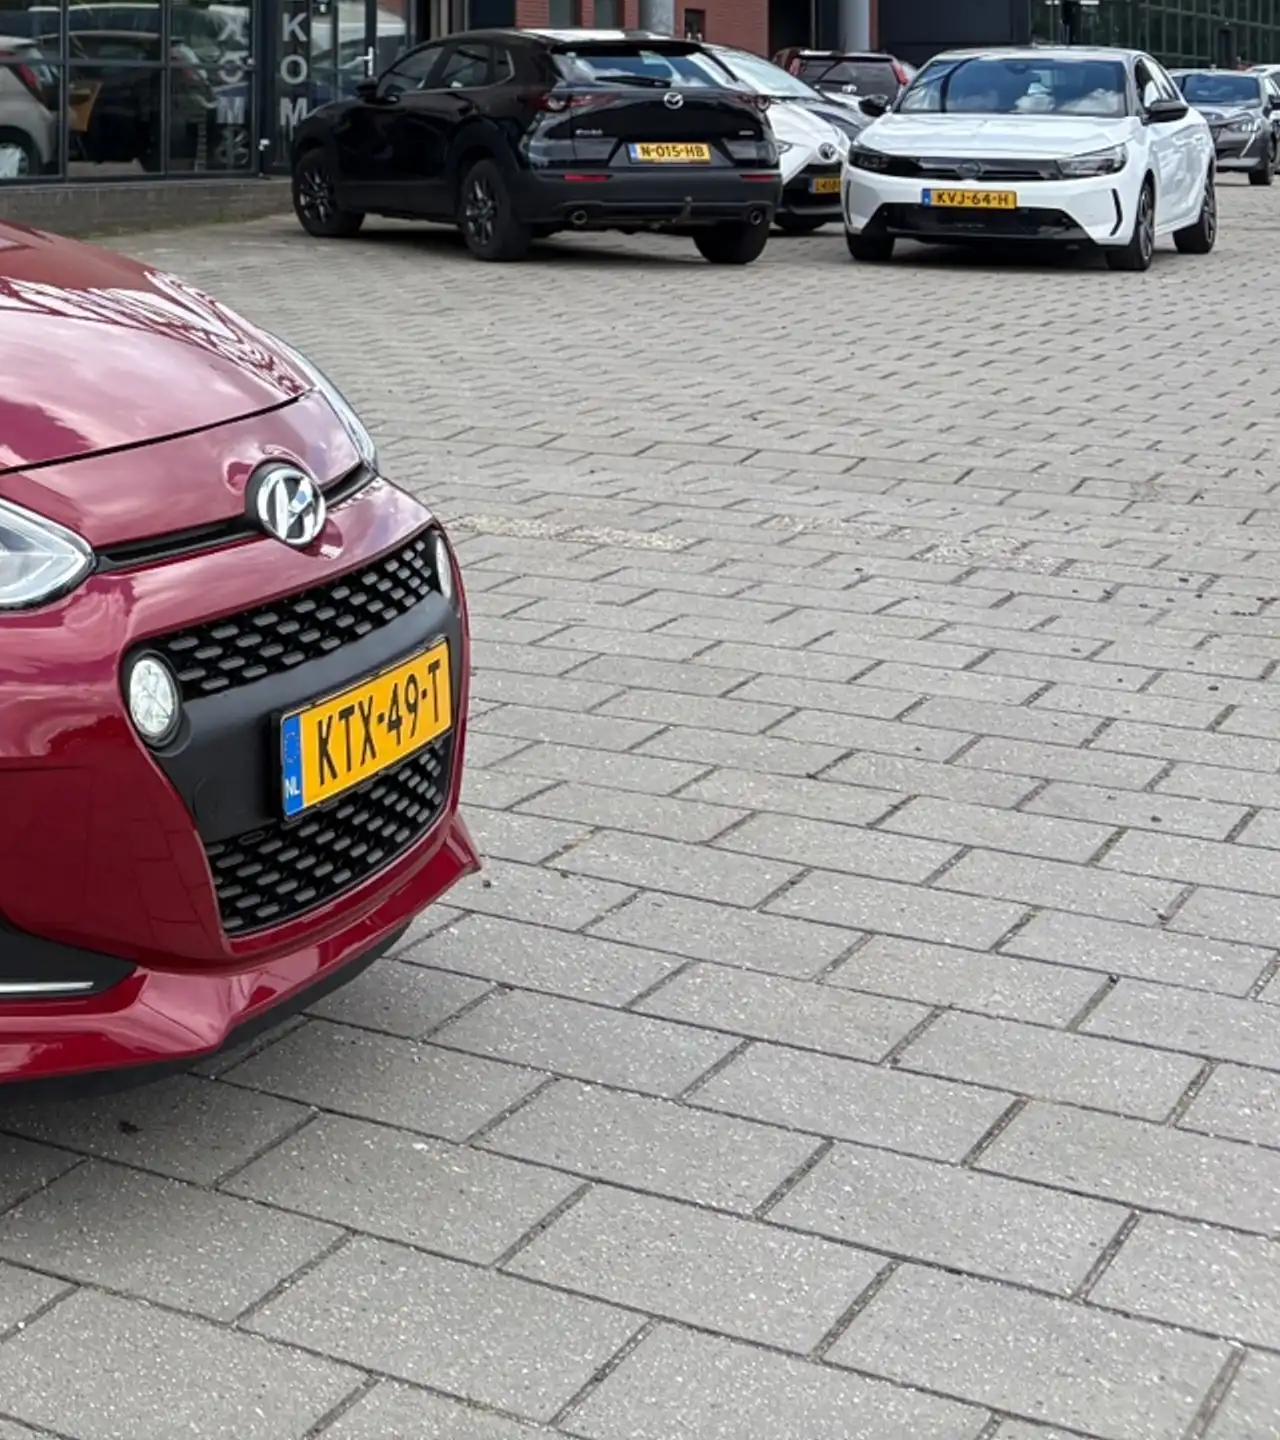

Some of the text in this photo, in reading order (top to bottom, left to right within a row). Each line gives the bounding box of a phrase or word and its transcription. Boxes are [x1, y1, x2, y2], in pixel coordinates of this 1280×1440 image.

[936, 191, 1009, 206] KVJ-64-H
[284, 659, 441, 799] NL KTX-49-T
